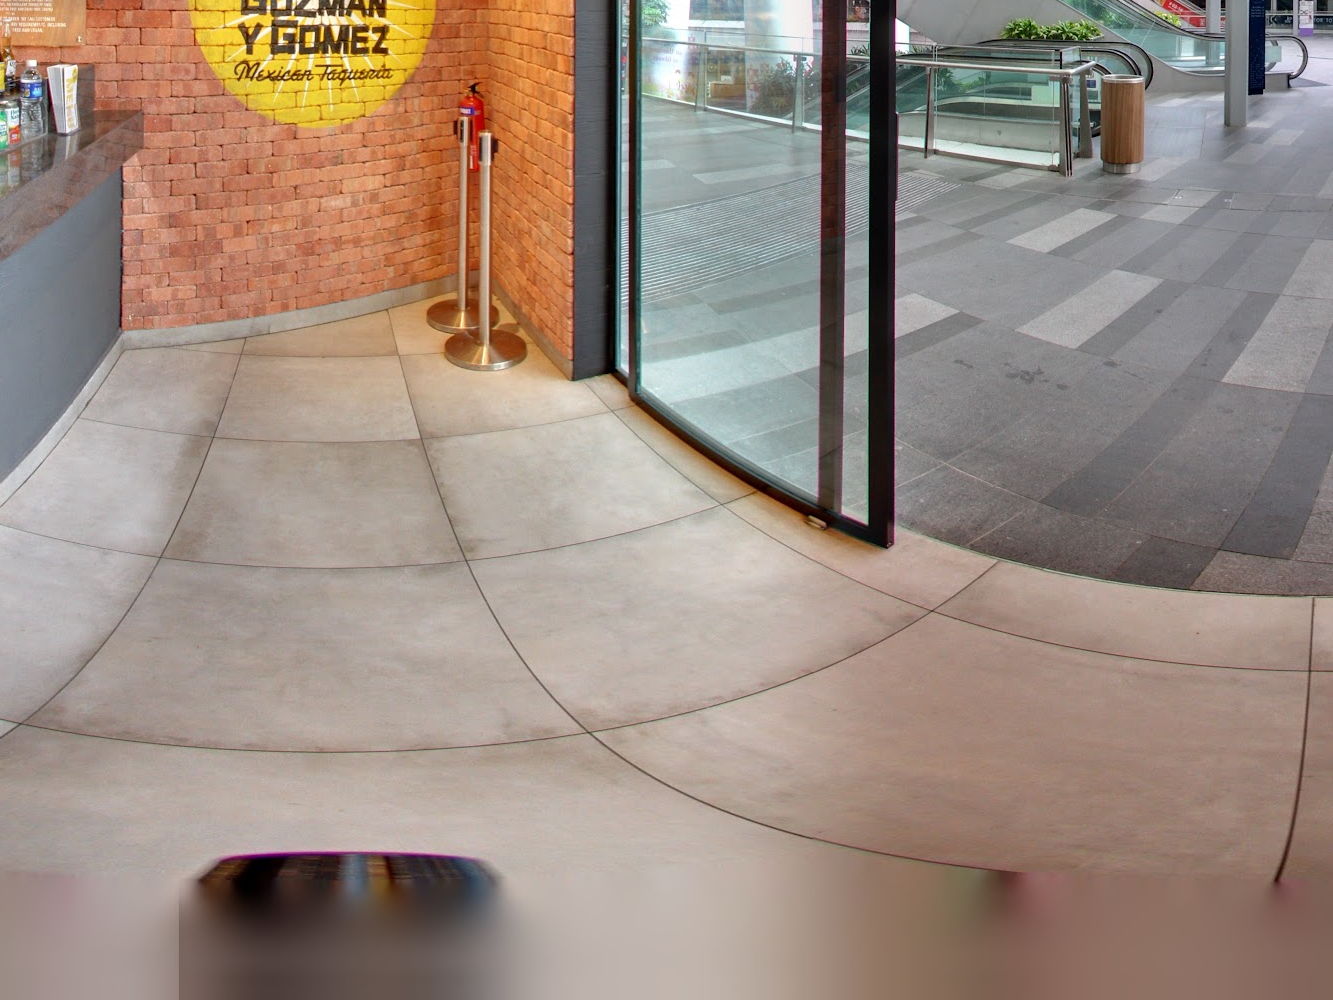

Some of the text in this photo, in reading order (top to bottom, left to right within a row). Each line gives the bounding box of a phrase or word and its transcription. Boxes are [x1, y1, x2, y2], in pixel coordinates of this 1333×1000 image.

[238, 20, 389, 55] Y GOMEZ
[233, 60, 393, 85] Mexican Taqueria
